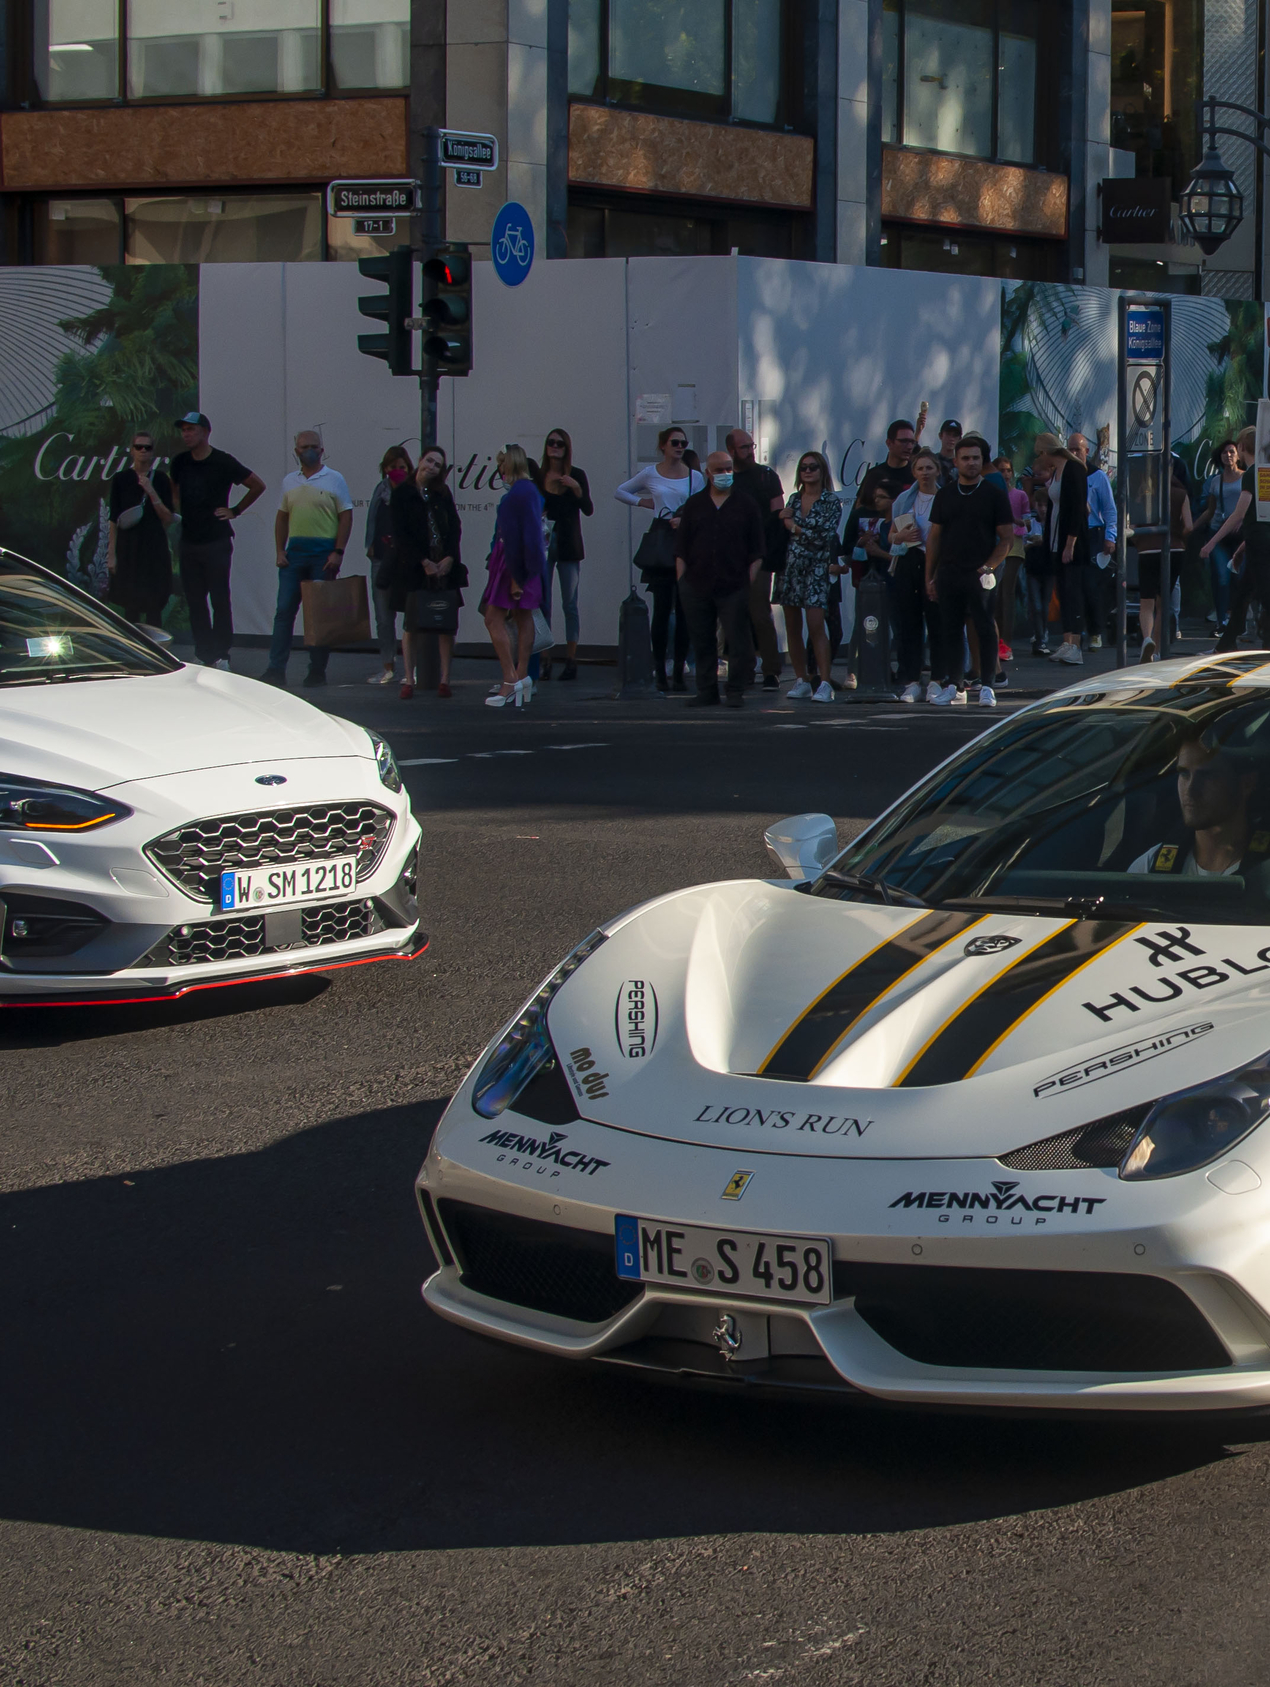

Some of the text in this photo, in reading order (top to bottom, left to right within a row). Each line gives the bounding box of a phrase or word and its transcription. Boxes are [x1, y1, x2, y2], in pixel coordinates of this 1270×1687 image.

[447, 140, 491, 160] Königsallee
[340, 190, 407, 208] Steinstraße
[1109, 205, 1159, 218] Cartier
[363, 221, 384, 231] 17-1
[1129, 320, 1162, 333] Blaue Zone
[1128, 337, 1162, 351] Königsallee
[1134, 431, 1155, 447] ZONE
[34, 431, 171, 481] Cartr
[467, 503, 482, 512] THE
[225, 894, 232, 904] D
[237, 875, 252, 904] W
[627, 979, 647, 1059] PERSHING
[1032, 1021, 1216, 1099] PERSHING
[692, 1104, 875, 1138] LION'S RUN
[477, 1129, 612, 1176] MENNYACHT
[496, 1154, 561, 1178] GROUP
[887, 1191, 1108, 1215] MENNYACHT
[937, 1214, 1047, 1226] GROUP
[624, 1252, 634, 1267] D
[640, 1225, 825, 1295] ME S 458
